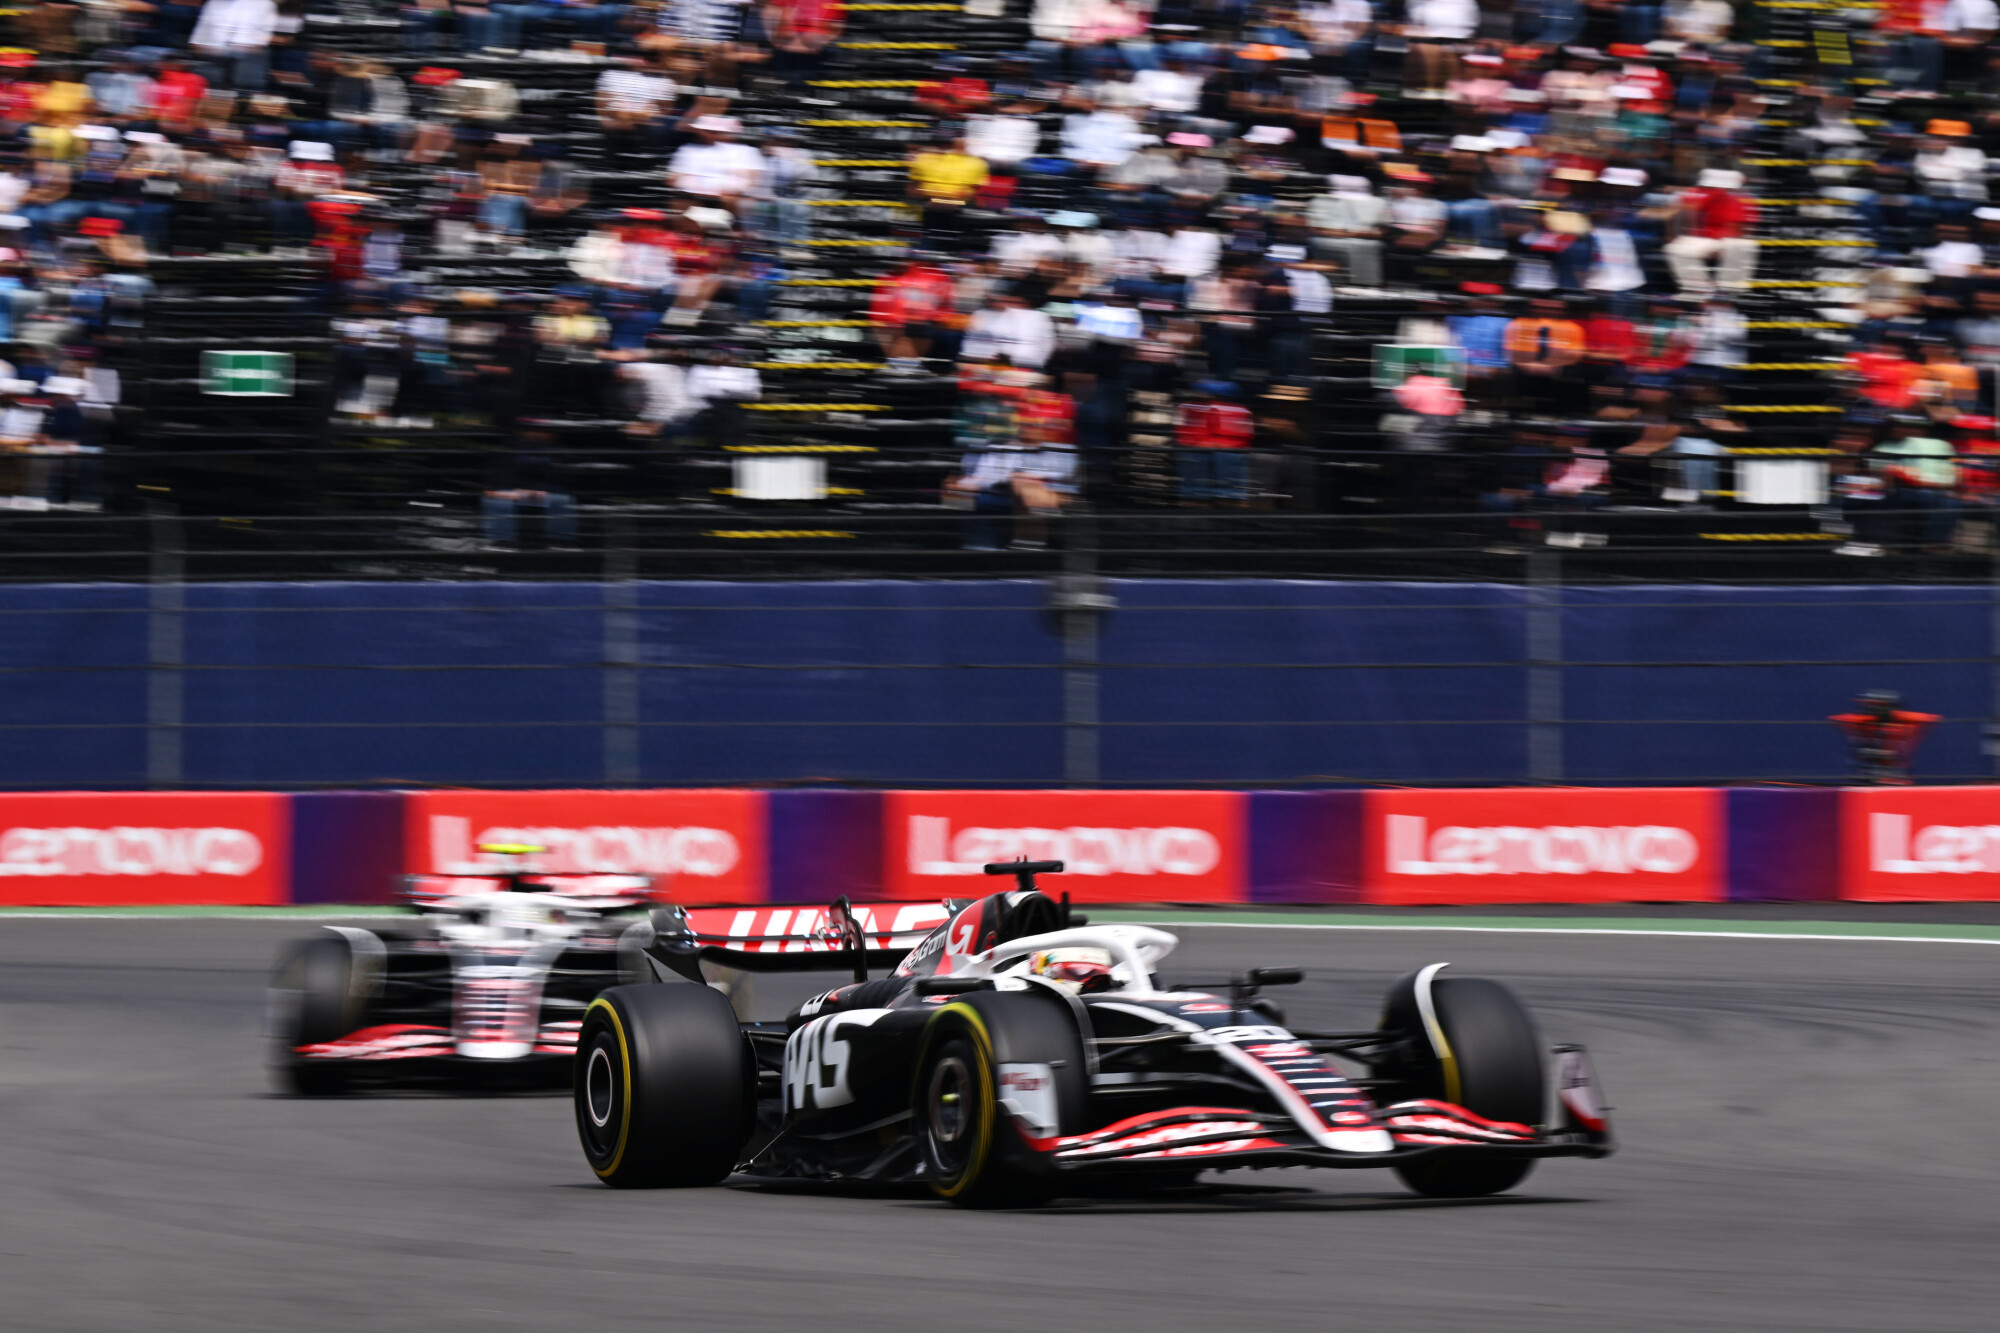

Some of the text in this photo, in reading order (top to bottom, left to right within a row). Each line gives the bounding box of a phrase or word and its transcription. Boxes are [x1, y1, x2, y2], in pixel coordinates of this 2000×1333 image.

[0, 827, 263, 876] enovo
[430, 814, 740, 875] Lenovo
[908, 814, 1219, 875] Lenovo
[1386, 813, 1698, 874] Lenovo
